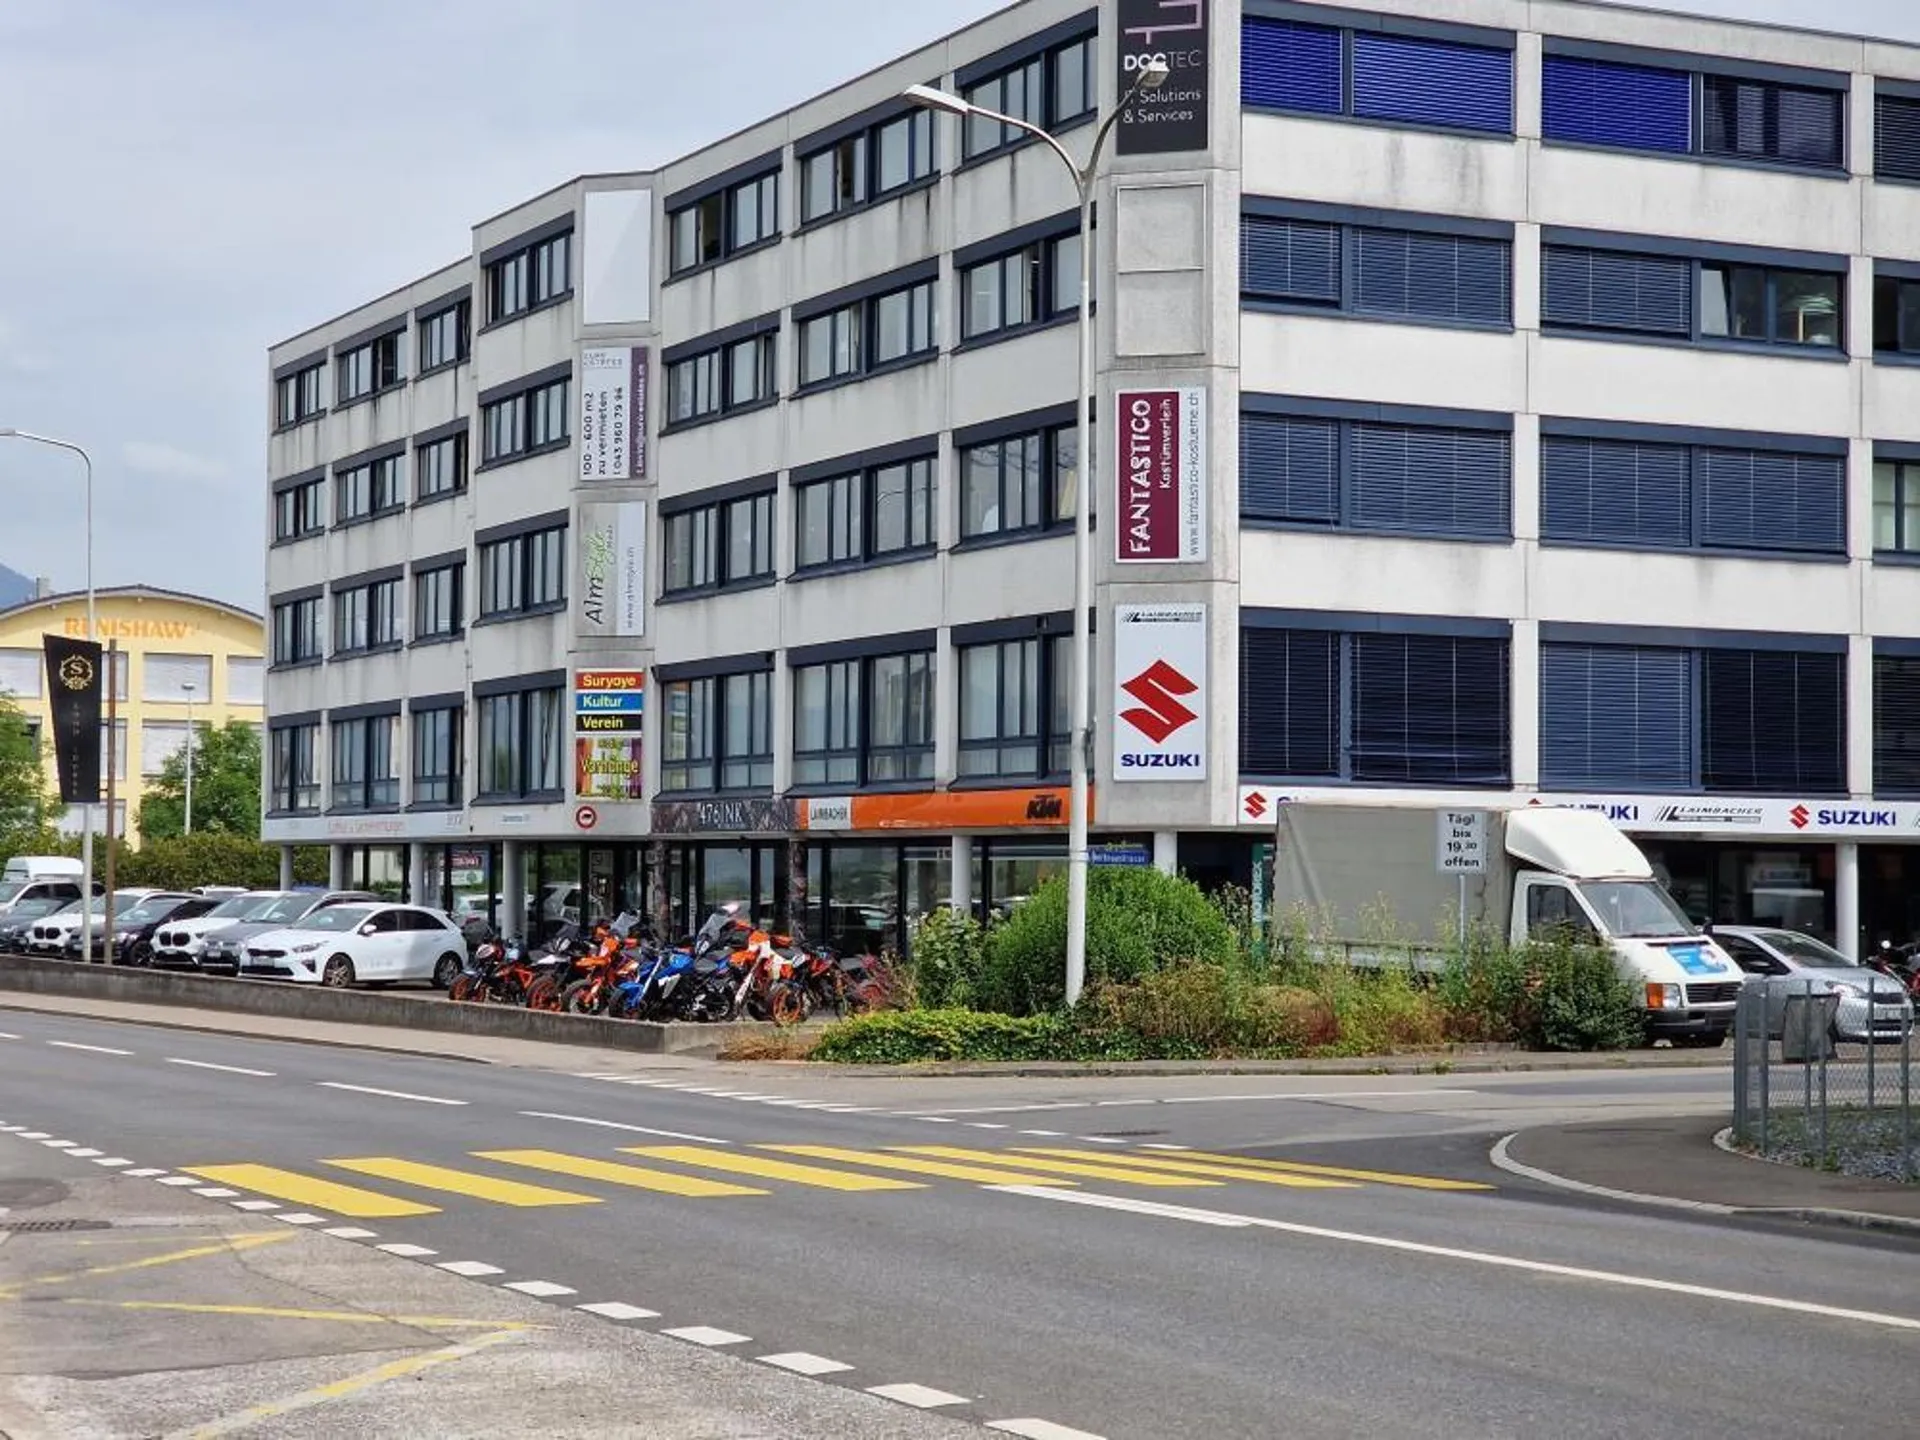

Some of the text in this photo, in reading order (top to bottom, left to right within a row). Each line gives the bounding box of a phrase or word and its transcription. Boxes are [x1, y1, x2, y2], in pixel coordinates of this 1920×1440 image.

[1139, 89, 1202, 104] Solutions
[1122, 109, 1194, 124] & Services
[614, 404, 623, 418] 79
[583, 415, 593, 441] 600
[597, 390, 608, 476] zu vermieten
[614, 421, 623, 445] 960
[1158, 398, 1173, 489] Kostümverleih
[583, 453, 593, 476] 100
[613, 446, 623, 469] 043
[1128, 399, 1152, 553] FANTASTICO
[583, 694, 622, 708] Kultur
[582, 715, 624, 728] Verein
[1120, 753, 1201, 767] SUZUKI
[1027, 794, 1063, 820] KTM
[1679, 805, 1764, 816] LAIMBACHER
[1817, 809, 1897, 826] SUZUKI
[1453, 828, 1471, 838] bis
[1445, 856, 1479, 867] offen
